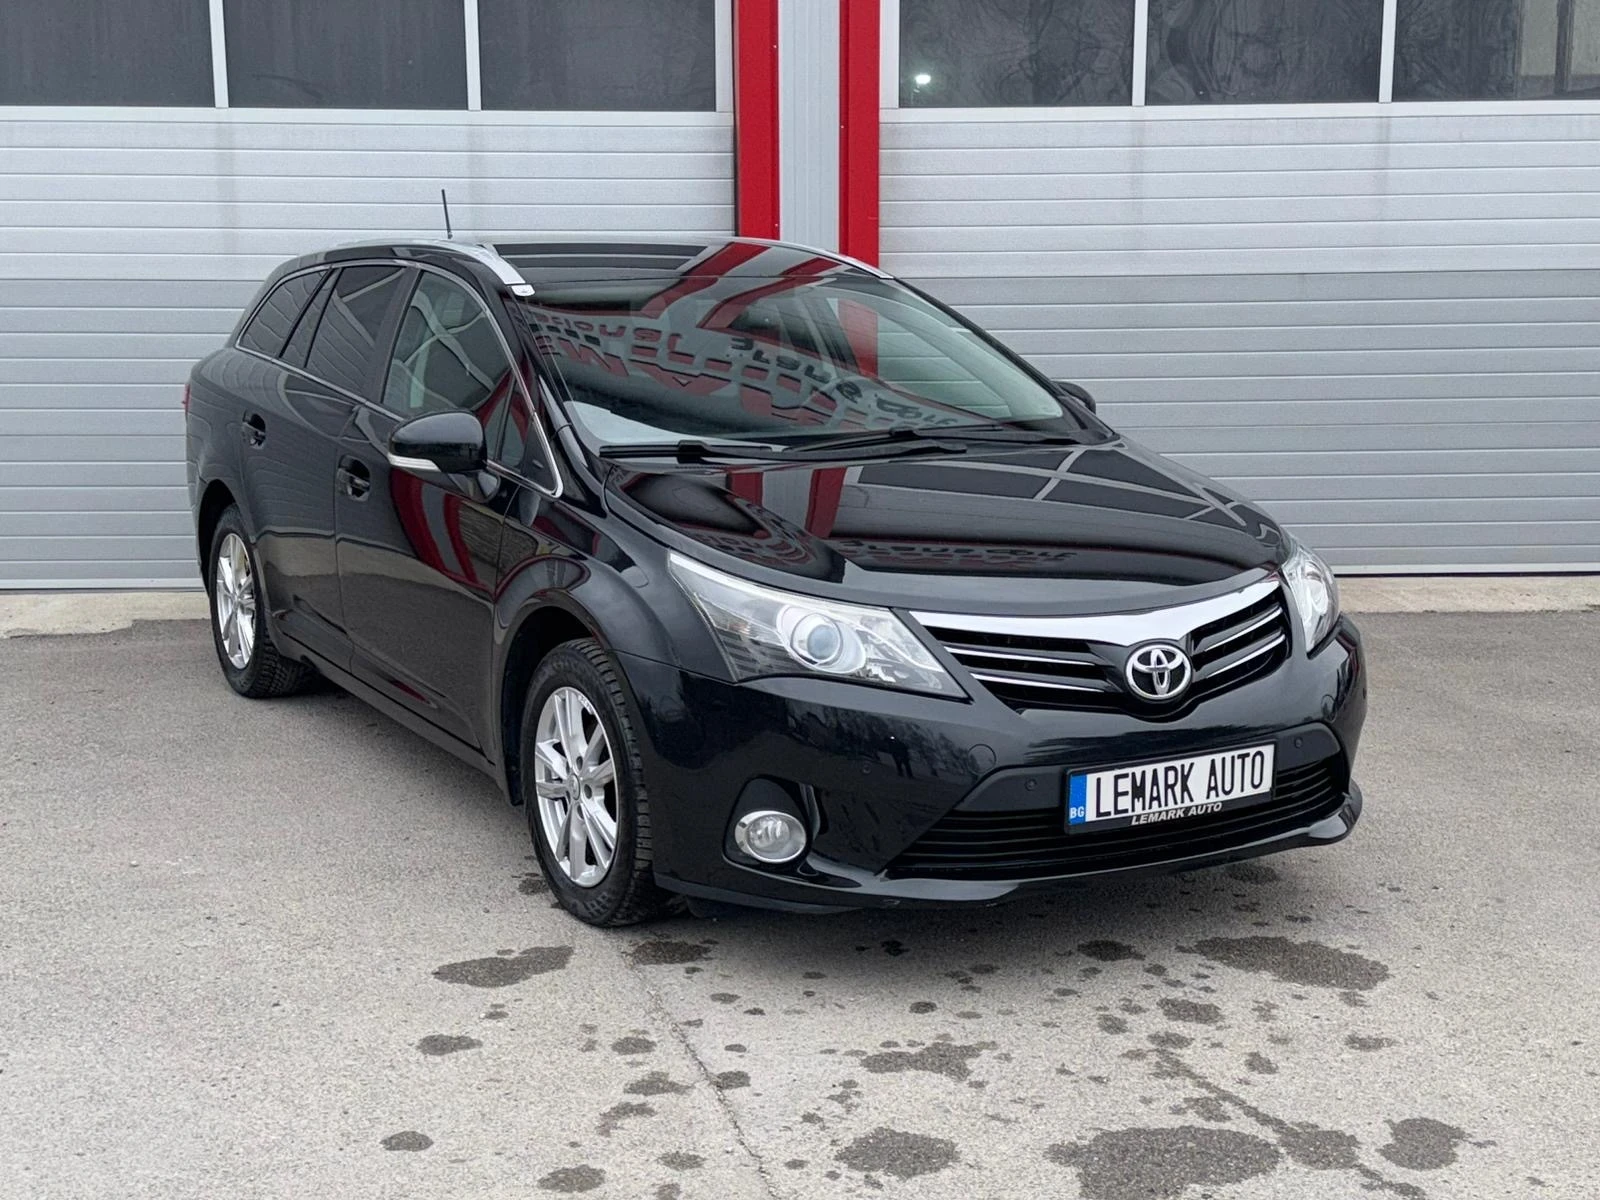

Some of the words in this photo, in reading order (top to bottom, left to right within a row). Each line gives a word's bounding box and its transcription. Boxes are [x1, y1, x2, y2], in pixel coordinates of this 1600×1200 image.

[1096, 762, 1195, 818] LEMARK
[1206, 750, 1265, 800] AUTO
[1069, 806, 1085, 819] BG
[1131, 807, 1186, 825] LEMARK
[1187, 802, 1223, 816] AUTO
